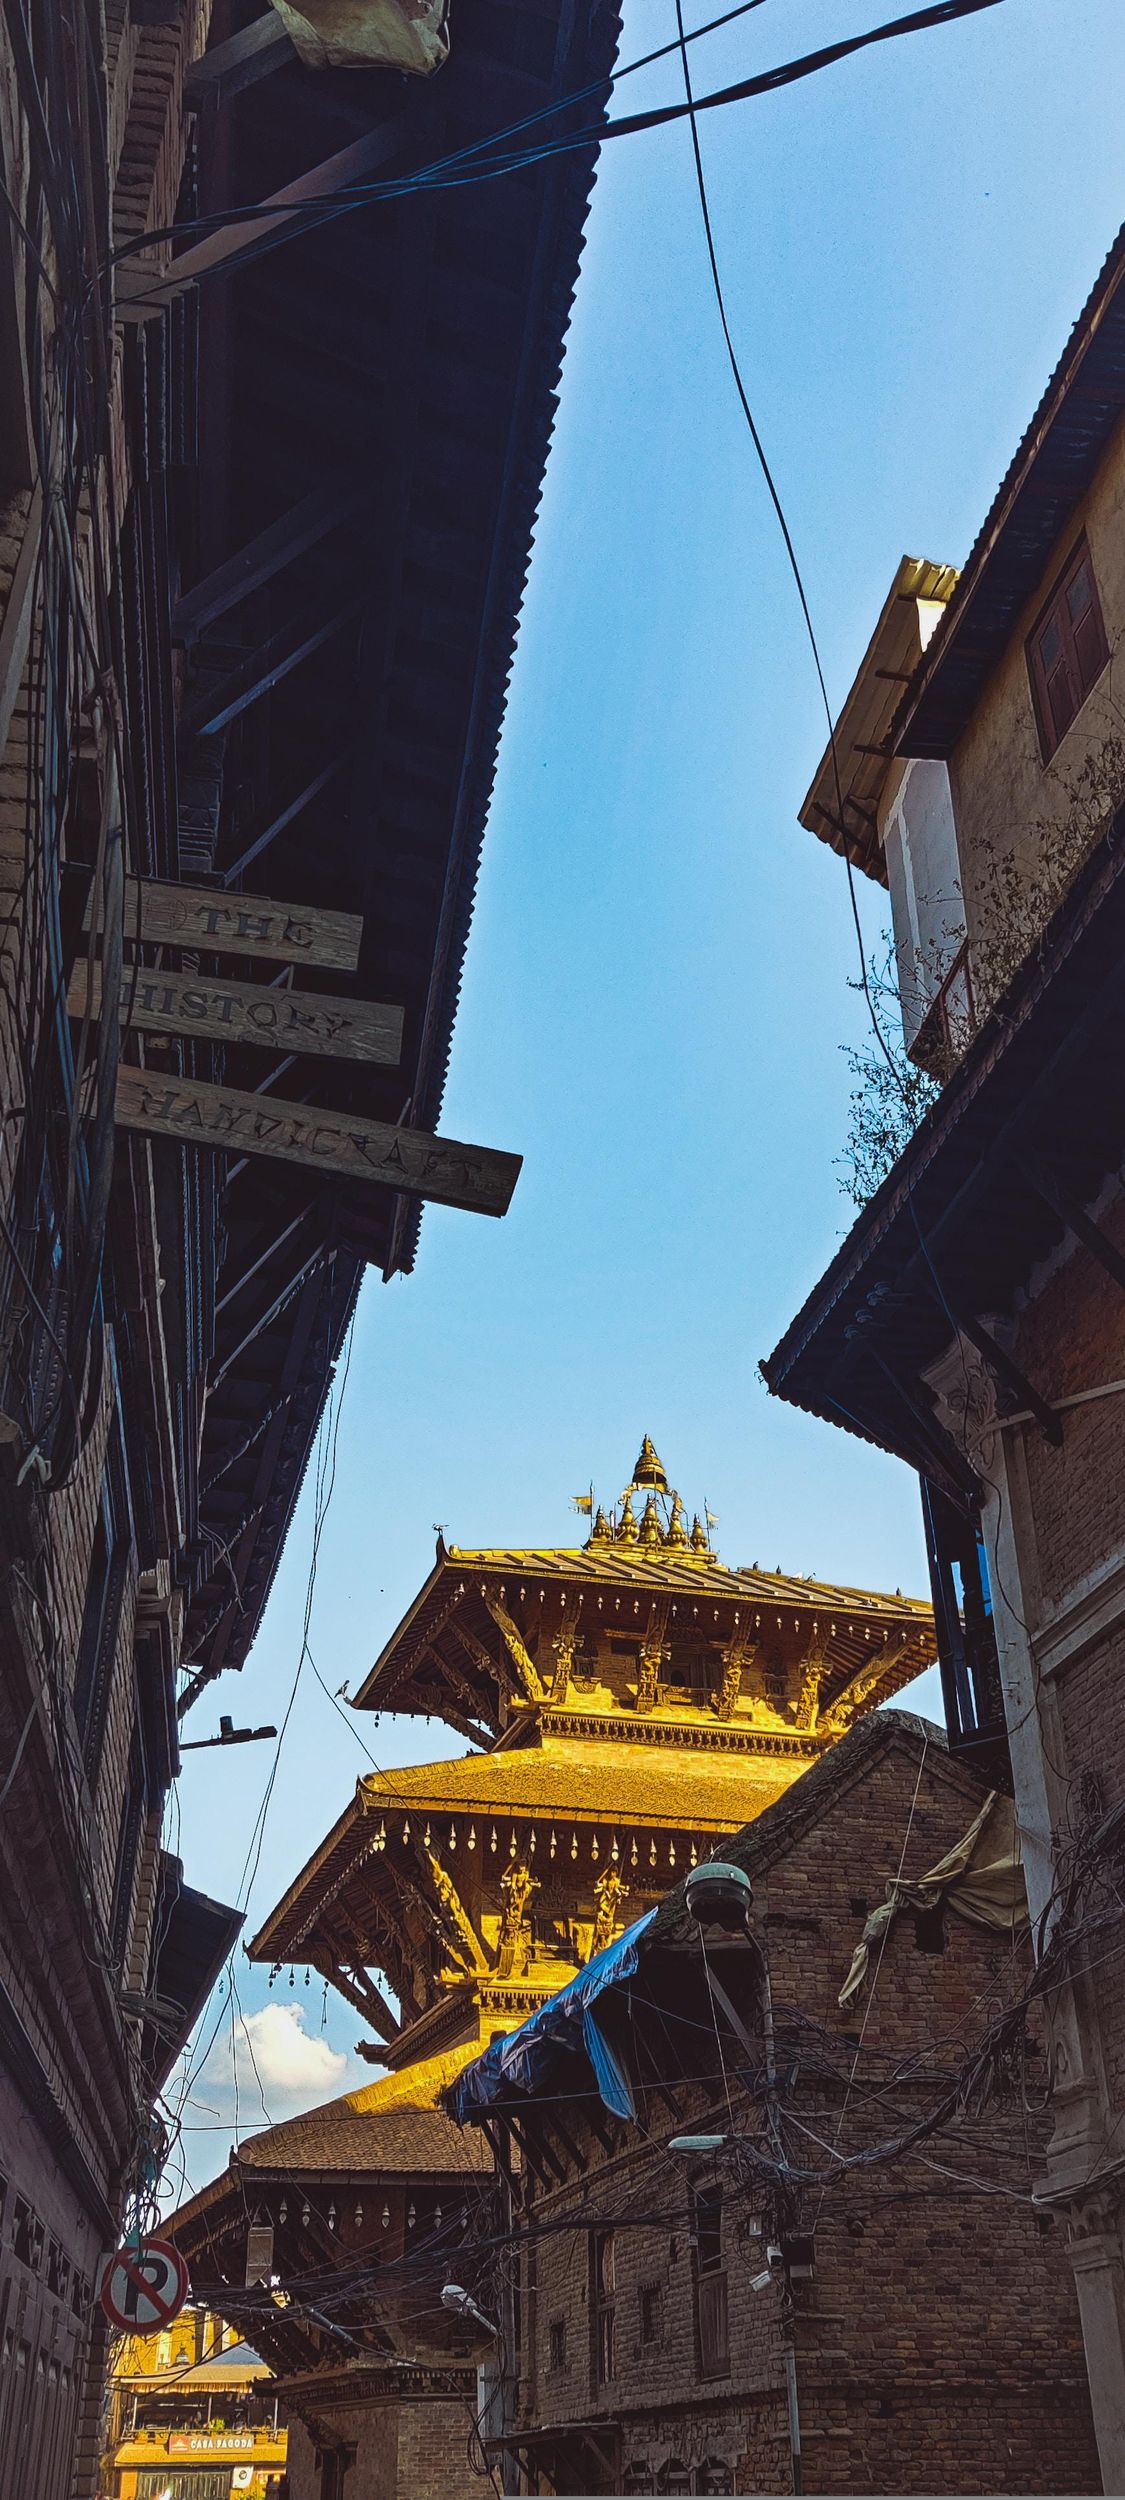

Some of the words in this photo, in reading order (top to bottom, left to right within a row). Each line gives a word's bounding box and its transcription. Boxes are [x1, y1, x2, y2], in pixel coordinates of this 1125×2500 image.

[196, 906, 315, 949] THE
[119, 982, 353, 1039] HISTORY
[138, 1084, 483, 1182] HANDICRAFT
[124, 2256, 169, 2317] P
[190, 2439, 214, 2450] CASA
[216, 2438, 253, 2450] PAGODA
